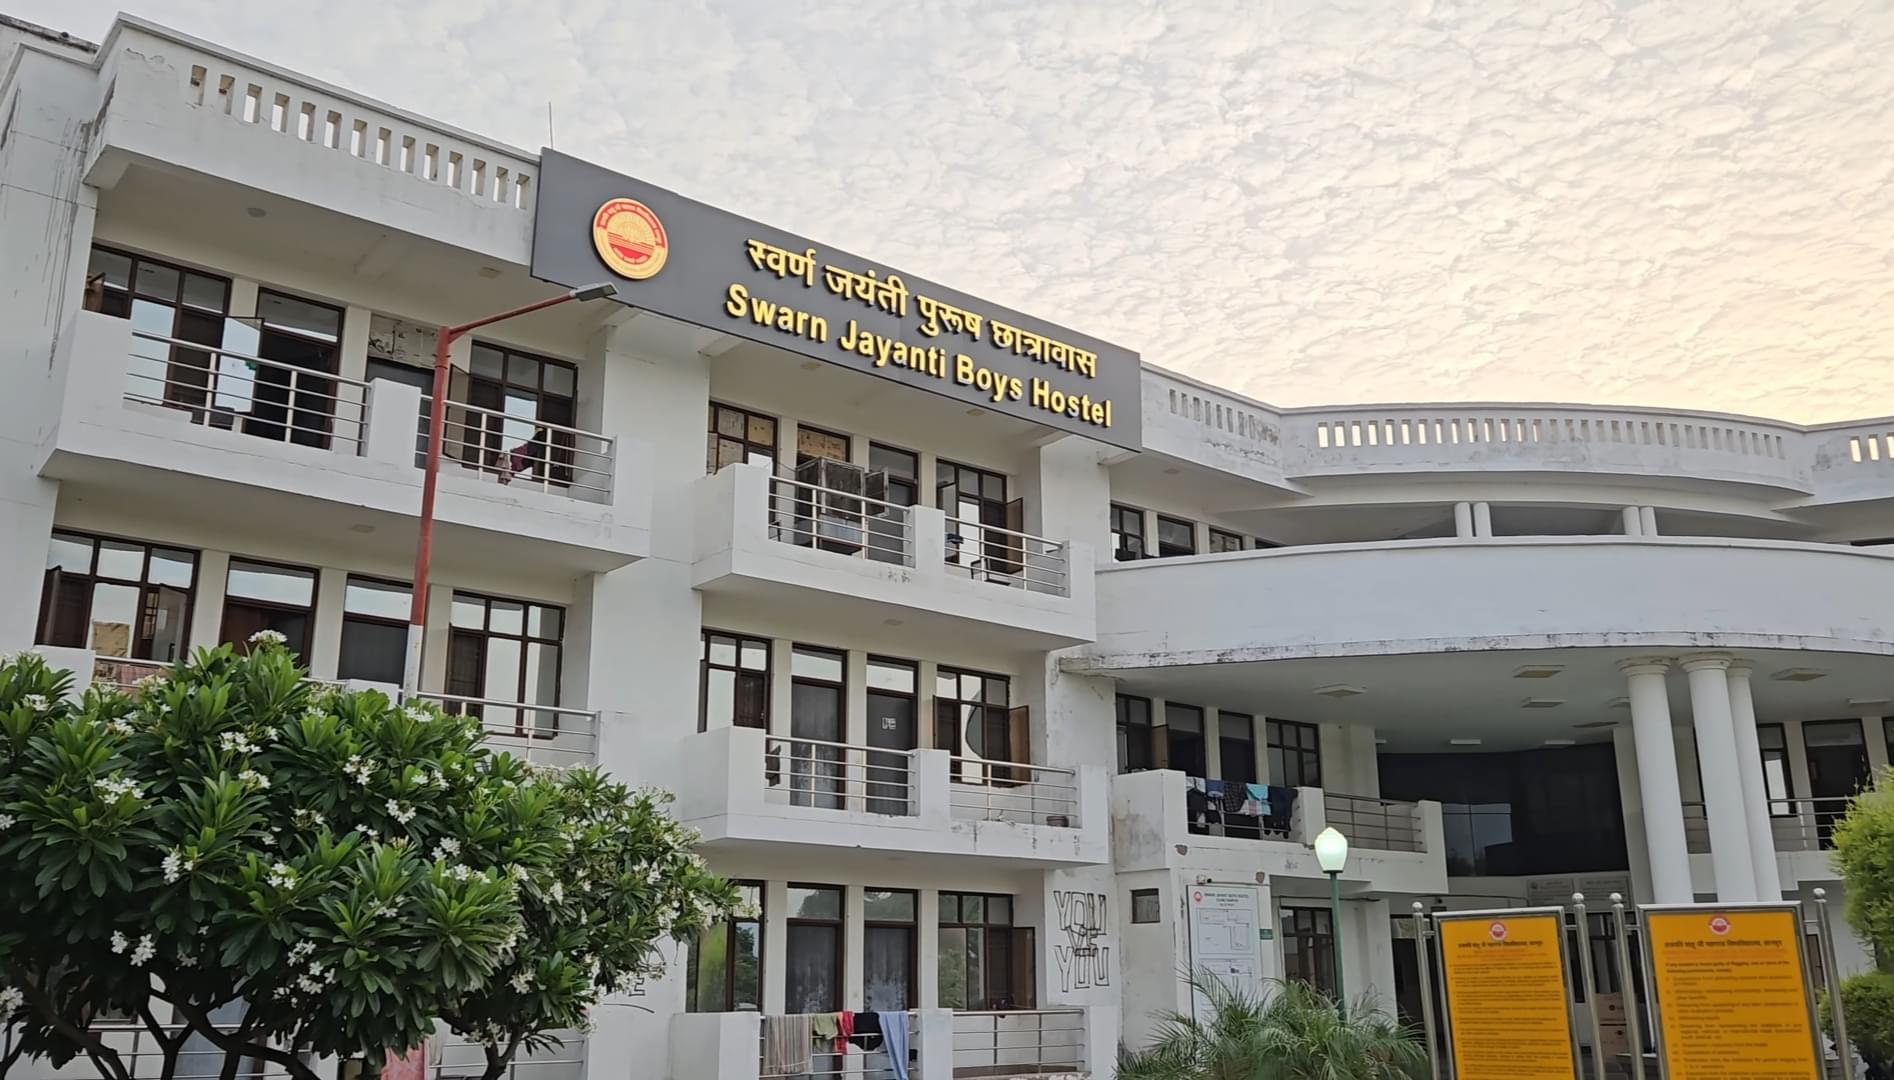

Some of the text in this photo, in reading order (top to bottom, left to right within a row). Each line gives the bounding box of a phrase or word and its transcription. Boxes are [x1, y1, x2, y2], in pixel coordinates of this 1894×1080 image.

[725, 283, 1112, 429] Swarn Jayanti Boys Hostel
[747, 239, 817, 287] स्वर्ण
[823, 265, 909, 317] जयंती
[989, 319, 1098, 379] छात्रावास
[1054, 944, 1110, 993] YOU
